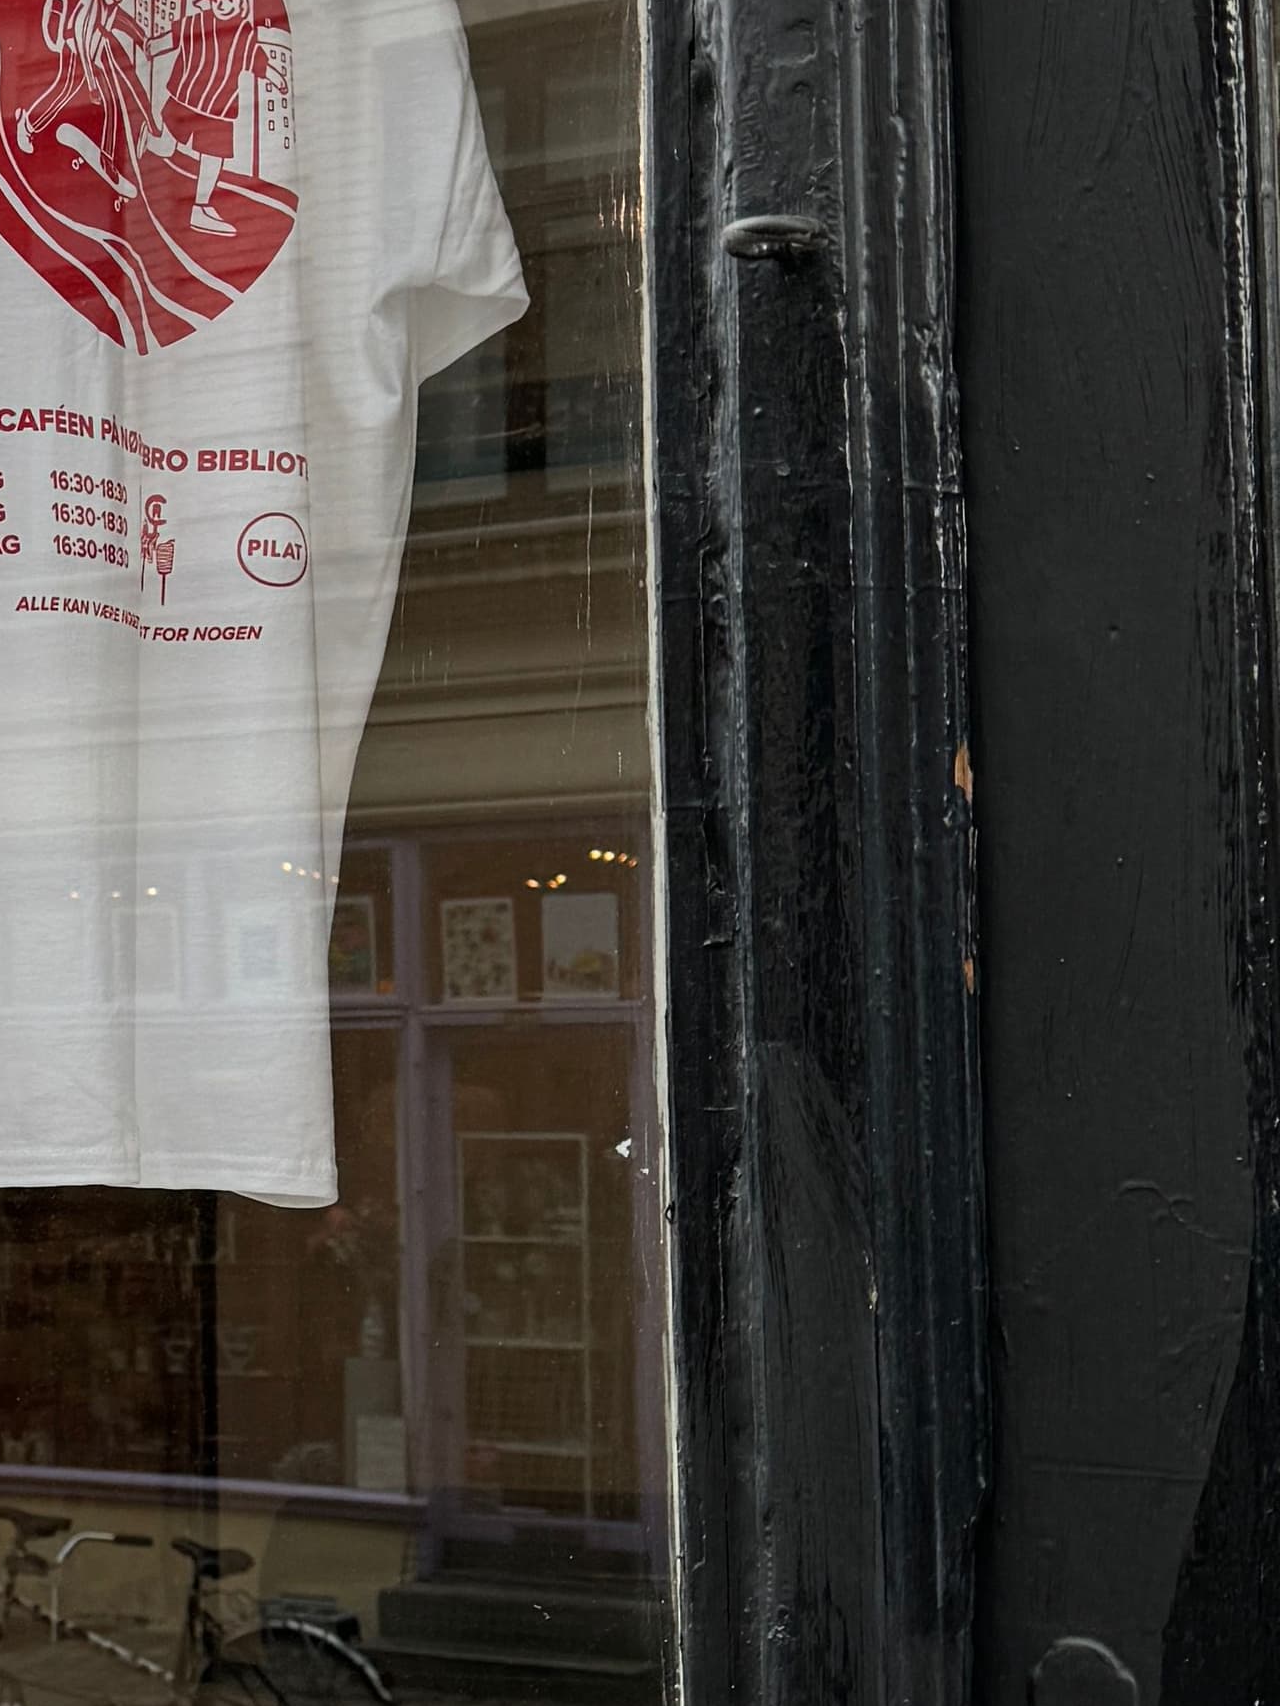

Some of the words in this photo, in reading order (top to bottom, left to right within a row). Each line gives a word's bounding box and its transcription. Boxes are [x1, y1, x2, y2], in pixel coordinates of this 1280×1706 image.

[15, 596, 60, 612] ALLE
[62, 597, 90, 615] KAN
[152, 626, 190, 642] FOR
[192, 625, 263, 642] NOGEN
